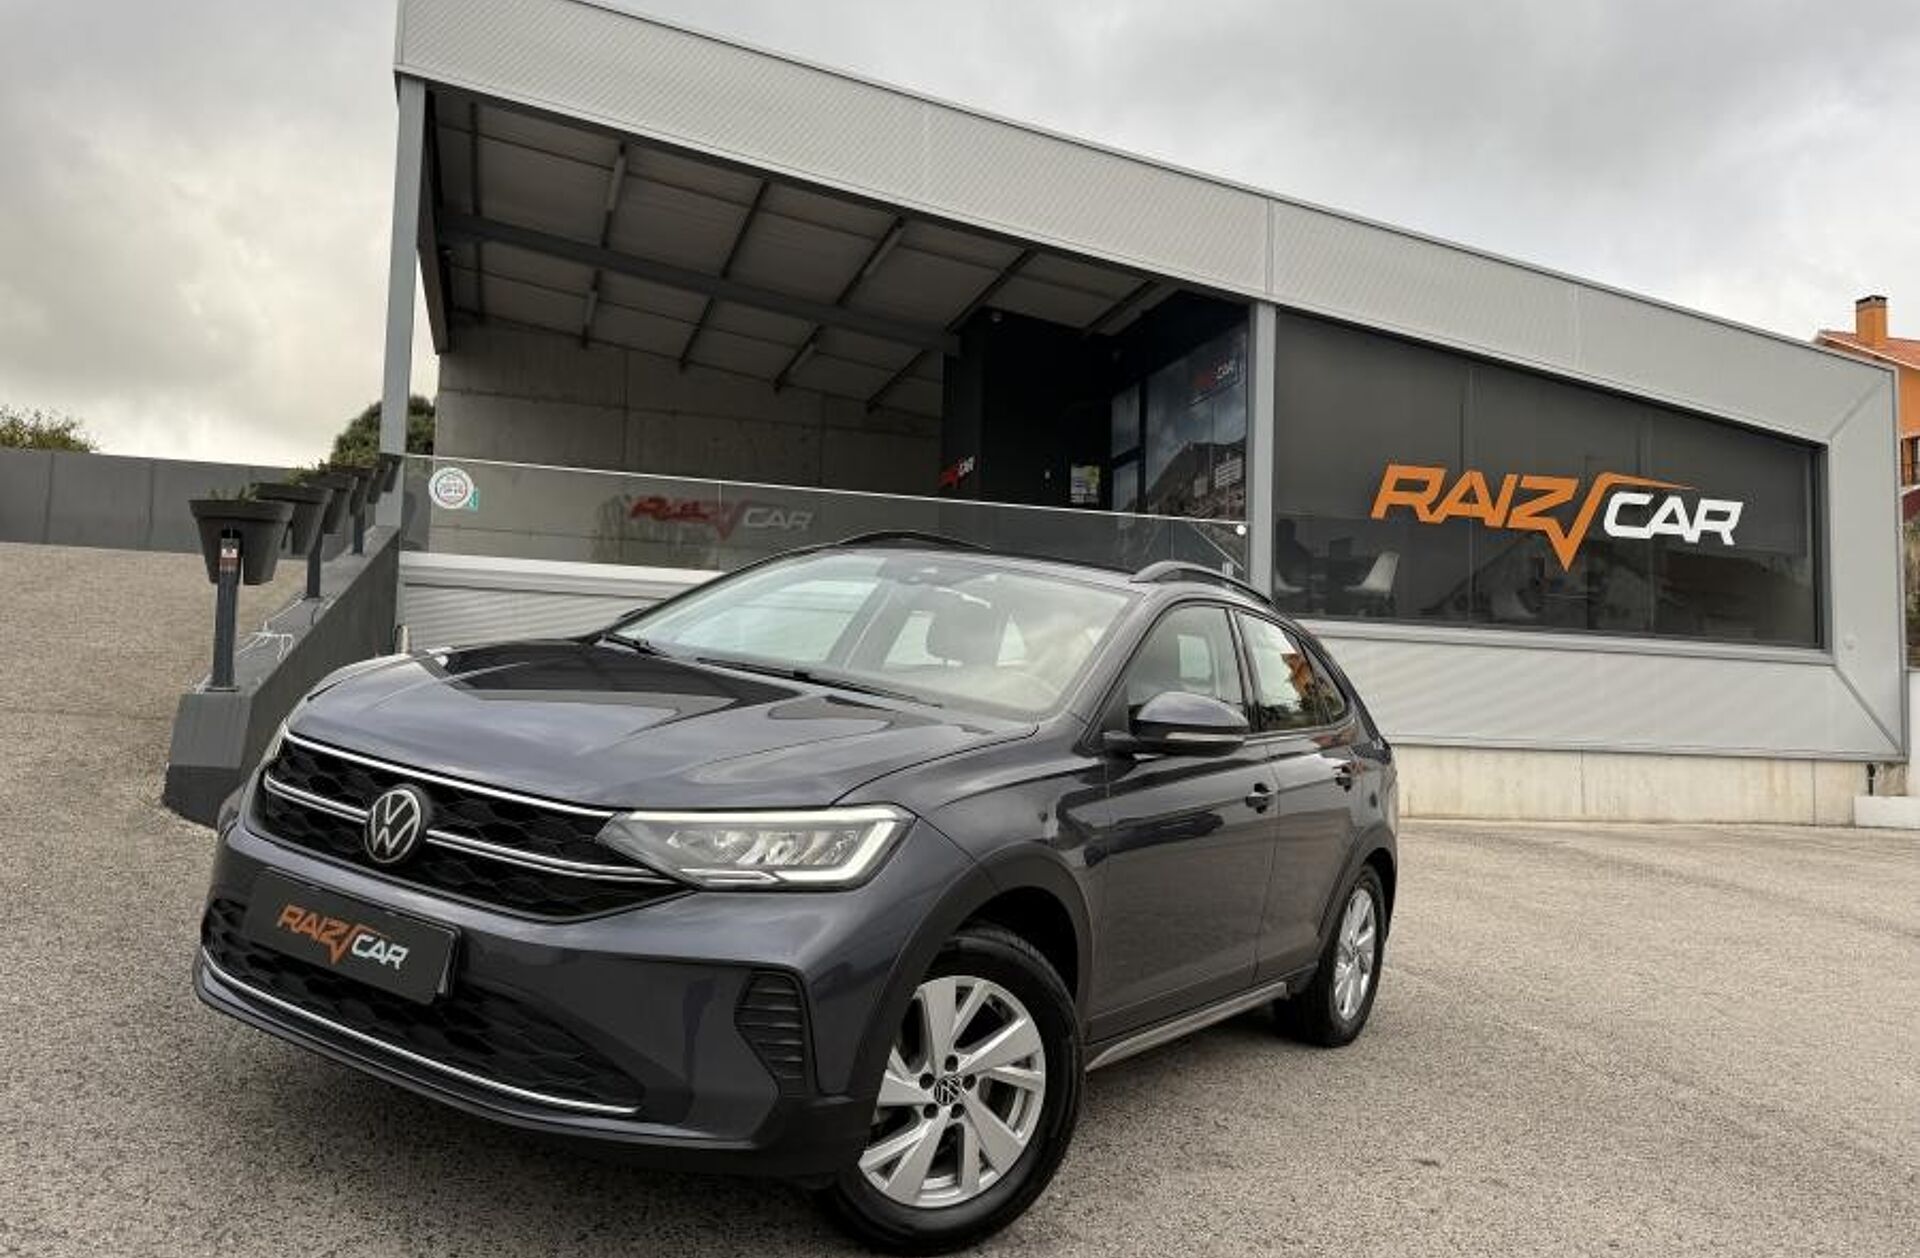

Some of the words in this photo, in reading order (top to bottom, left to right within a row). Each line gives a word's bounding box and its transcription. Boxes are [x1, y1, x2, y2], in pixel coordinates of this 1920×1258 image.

[742, 507, 814, 531] CAR
[1604, 490, 1744, 546] CAR
[351, 933, 410, 970] CAR
